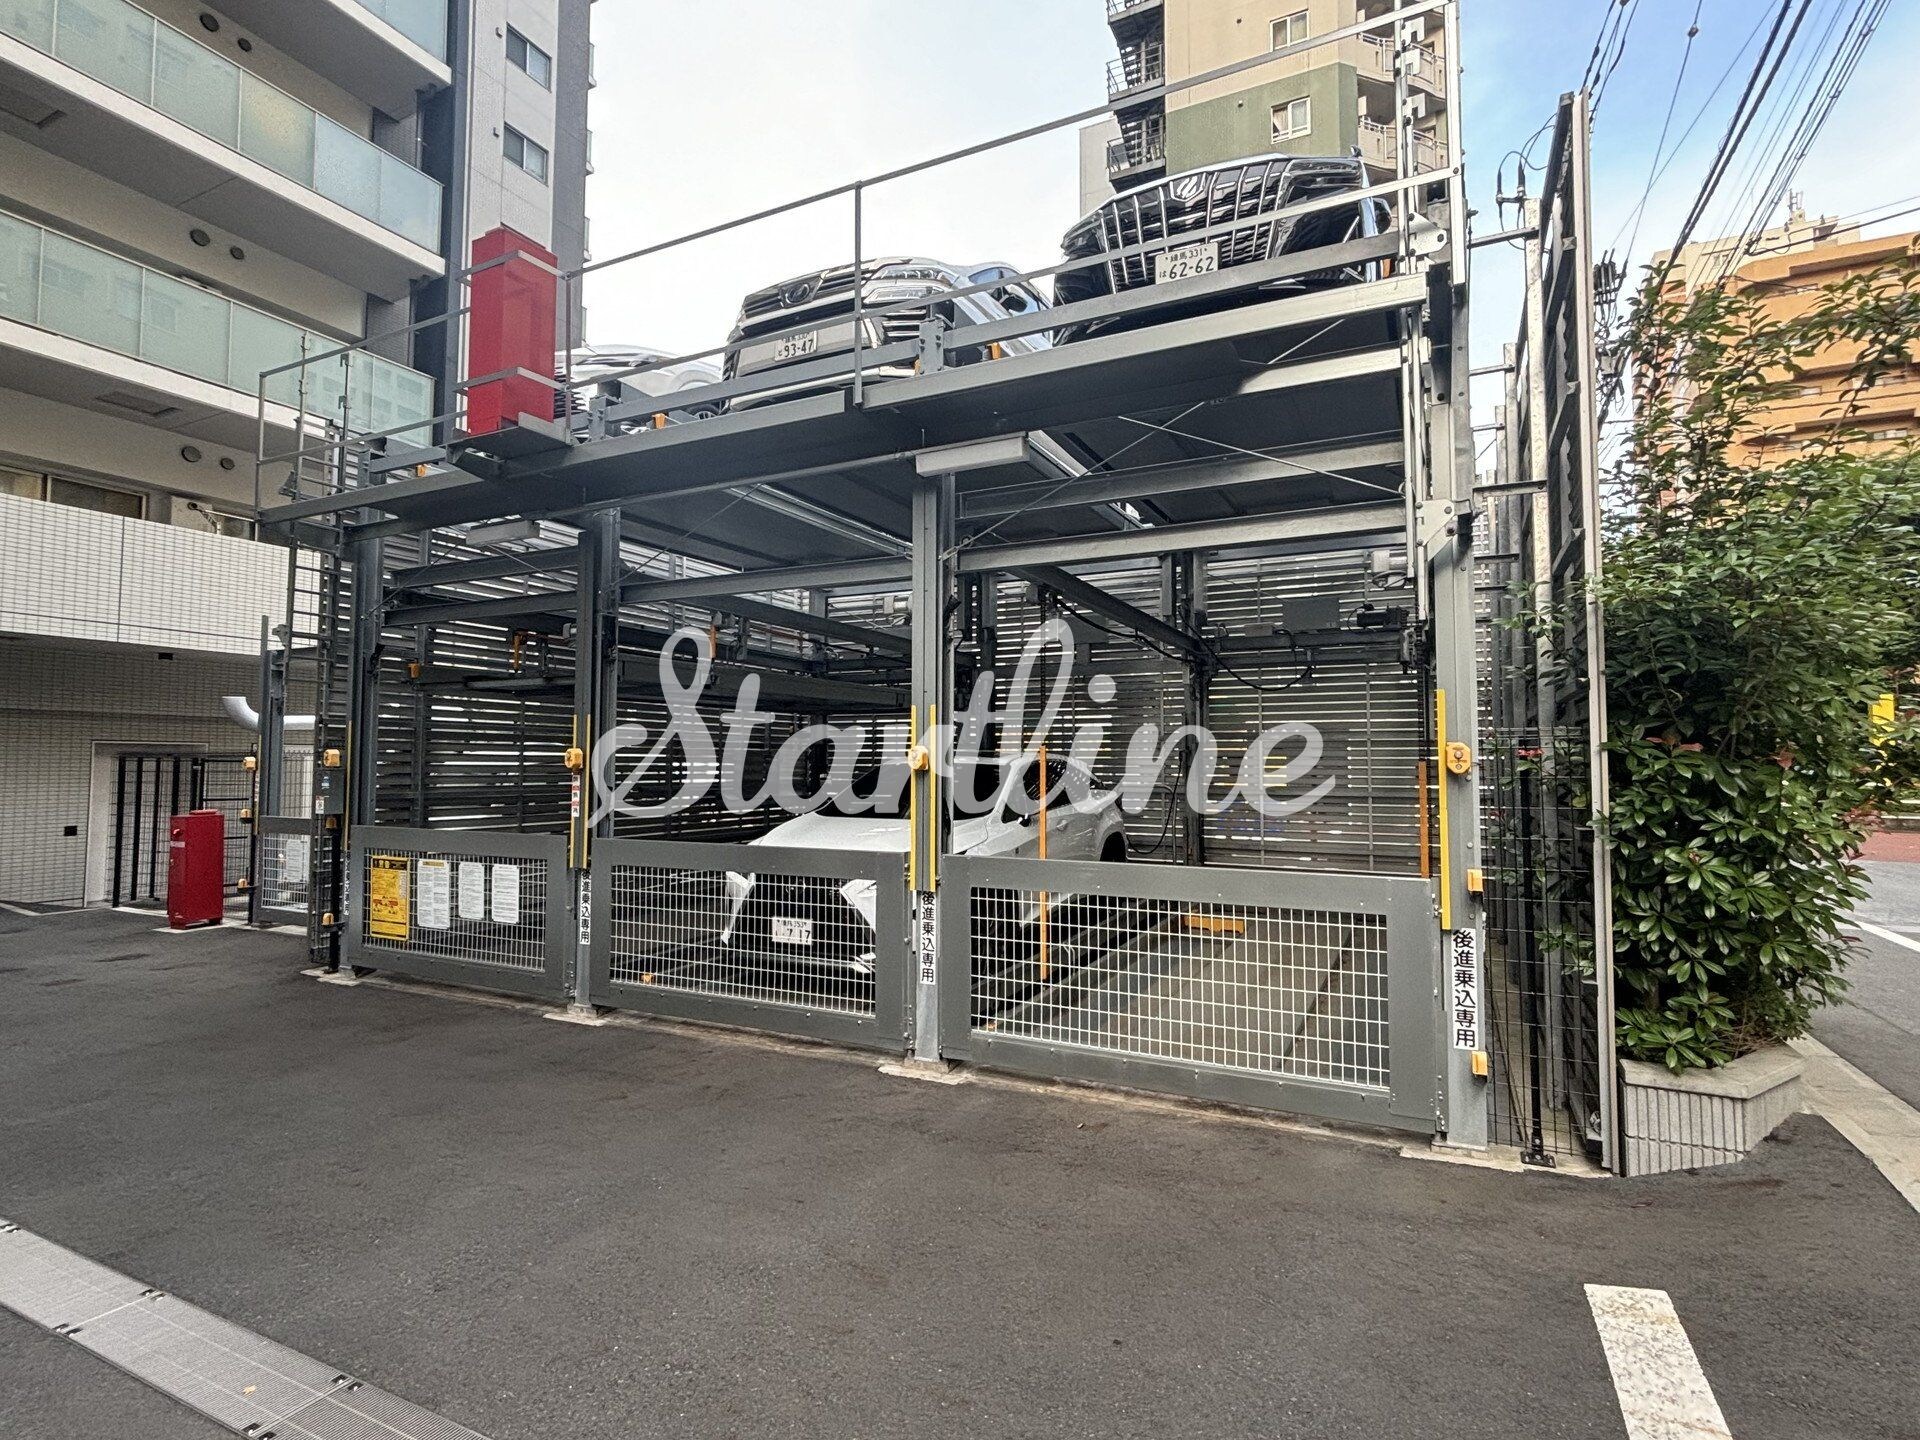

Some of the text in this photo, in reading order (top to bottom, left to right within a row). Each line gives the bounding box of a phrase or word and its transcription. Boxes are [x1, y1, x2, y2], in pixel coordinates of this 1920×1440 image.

[1169, 256, 1214, 279] 62-62
[784, 338, 814, 358] 93-47
[921, 891, 935, 983] 後進乗込専用
[1453, 930, 1476, 1048] 後進乗込専用
